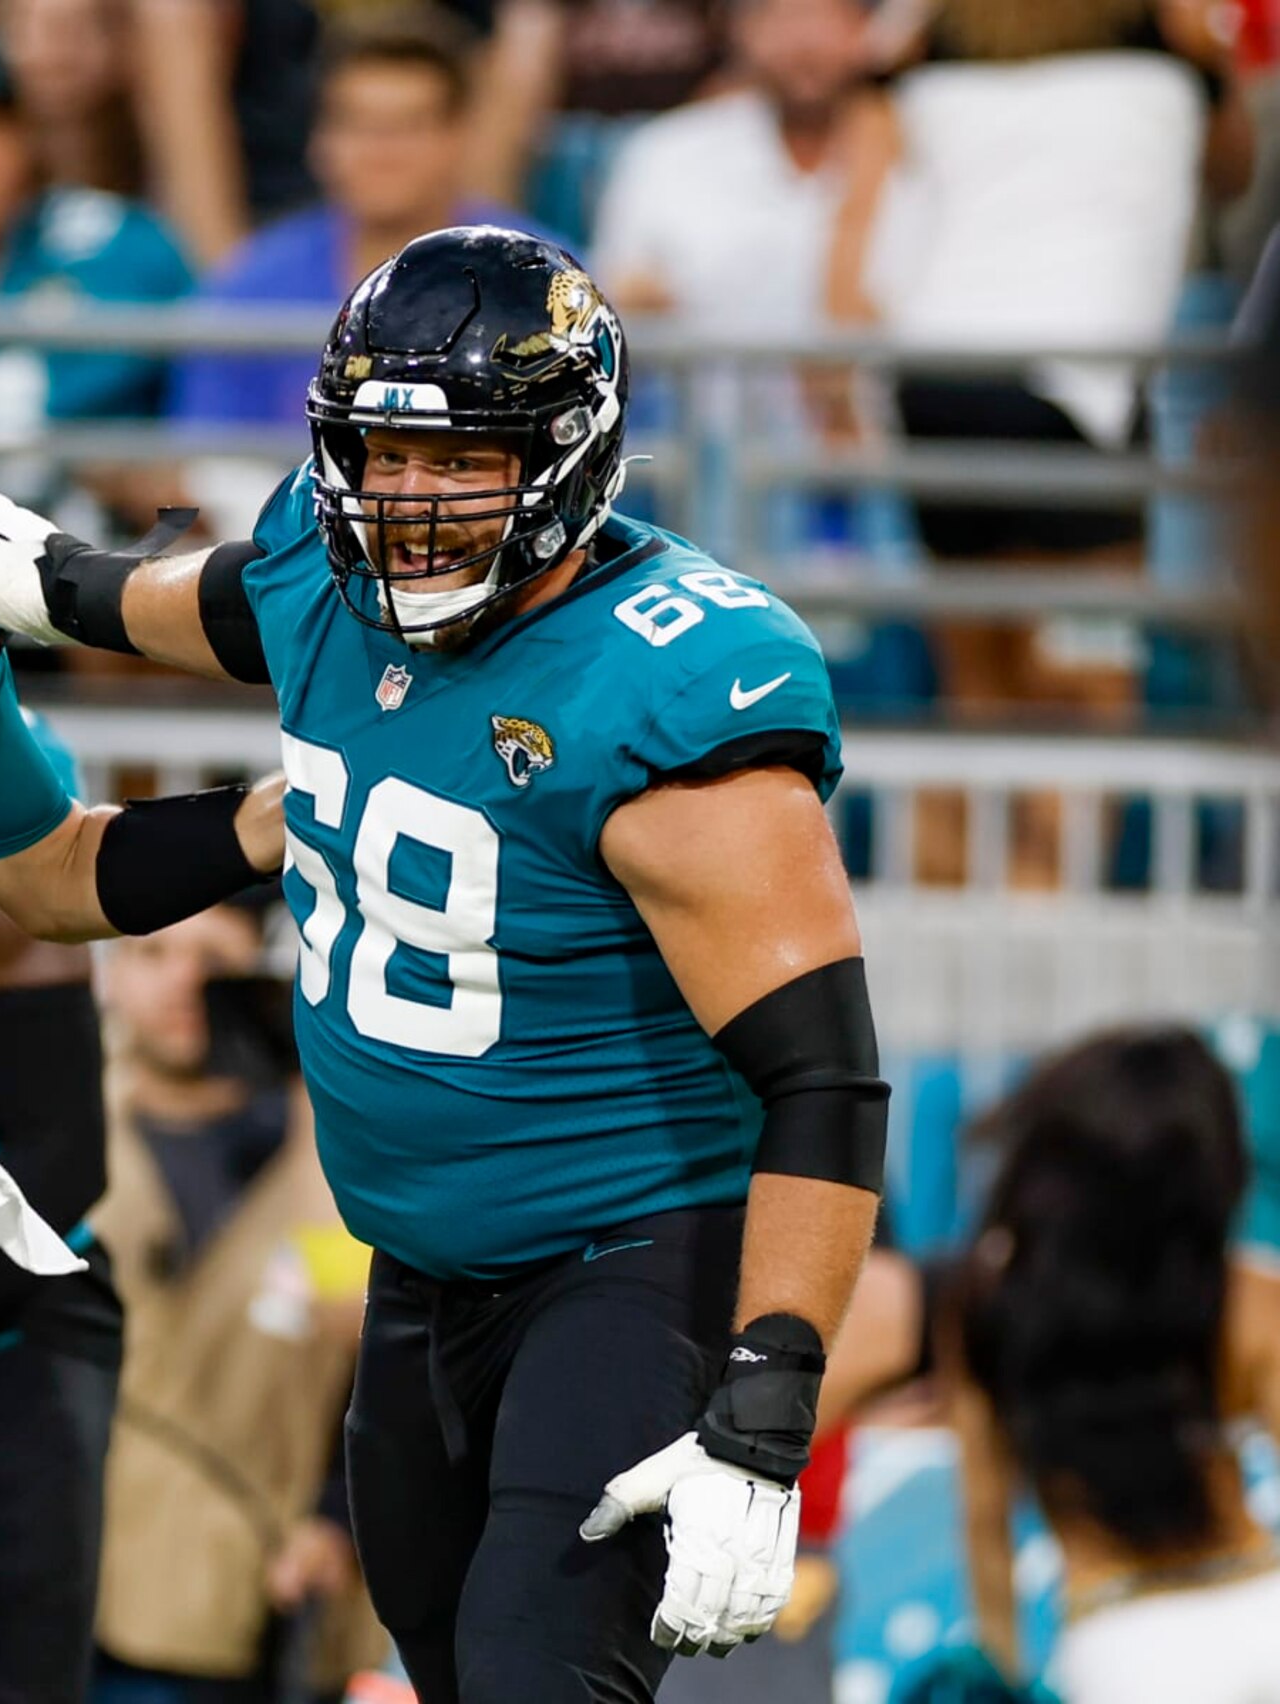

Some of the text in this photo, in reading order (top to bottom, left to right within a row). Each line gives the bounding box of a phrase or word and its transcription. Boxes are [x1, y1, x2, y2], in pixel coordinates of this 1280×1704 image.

[376, 387, 415, 411] JAX
[613, 571, 770, 648] 68
[280, 729, 502, 1058] 68
